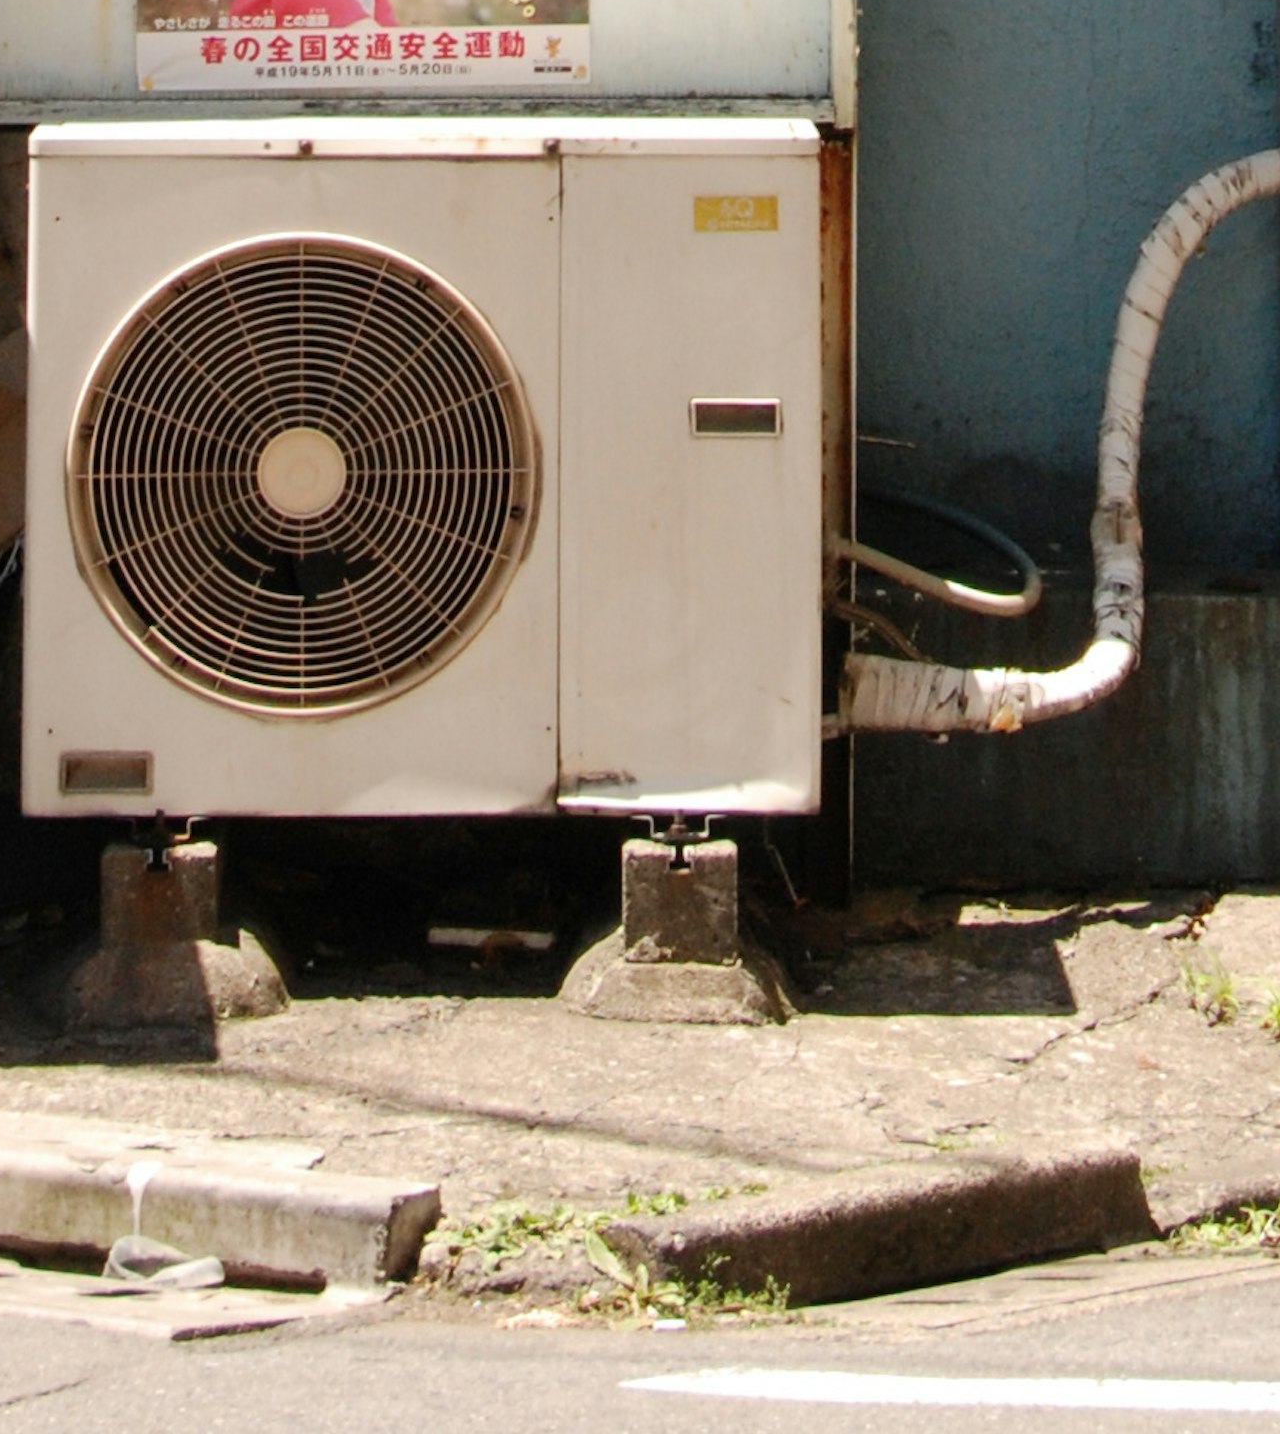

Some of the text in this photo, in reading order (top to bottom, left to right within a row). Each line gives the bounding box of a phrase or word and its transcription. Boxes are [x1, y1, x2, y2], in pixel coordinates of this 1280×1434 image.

[200, 30, 527, 66] 春の全国交通安全運動
